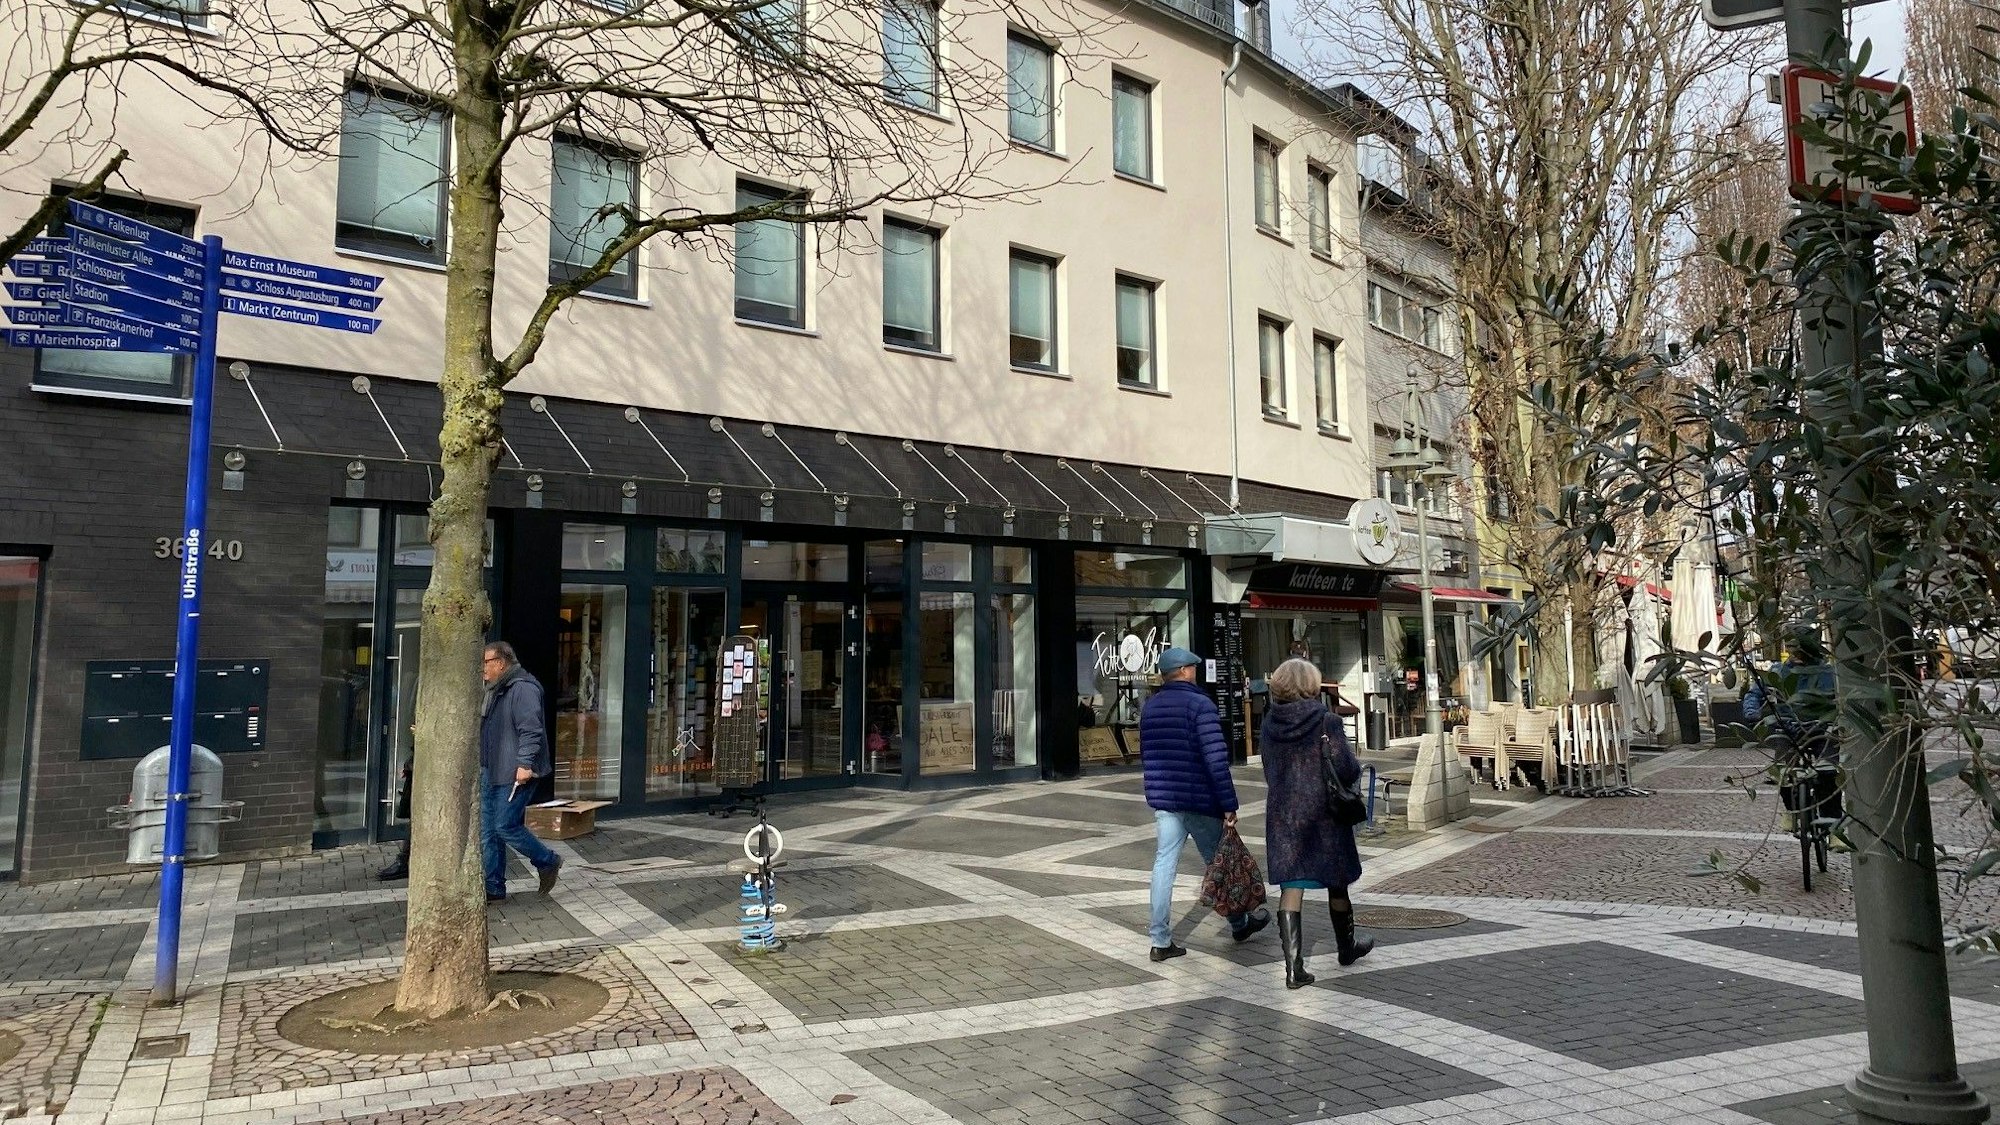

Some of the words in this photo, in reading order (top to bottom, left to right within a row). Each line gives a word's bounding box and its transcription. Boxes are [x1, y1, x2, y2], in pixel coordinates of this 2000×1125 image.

[108, 217, 150, 240] Falkenlust
[181, 243, 196, 255] 2300
[78, 233, 130, 259] Falkenluster
[132, 250, 154, 266] Allee
[183, 267, 195, 278] 300
[225, 253, 247, 267] Max
[250, 258, 274, 272] Ernst
[277, 262, 318, 279] Museum
[349, 277, 363, 287] 900
[364, 280, 371, 288] m
[37, 287, 70, 299] Giesle
[76, 258, 126, 282] Schlosspark
[181, 290, 193, 301] 300
[193, 295, 200, 303] m
[255, 280, 285, 295] Schloss
[286, 287, 340, 306] Augustusburg
[348, 298, 362, 307] 400
[17, 310, 61, 323] Brühler
[75, 283, 109, 302] Stadion
[181, 313, 192, 324] 100
[192, 318, 199, 326] m
[238, 301, 269, 315] Markt
[272, 306, 320, 324] (Zentrum)
[347, 319, 361, 329] 100
[362, 323, 370, 331] m
[34, 333, 121, 349] Marienhospital
[85, 312, 154, 338] Franziskanerhof
[179, 336, 190, 347] 100
[190, 341, 198, 349] m
[183, 528, 200, 599] Uhlstraße
[208, 539, 243, 560] 40
[690, 762, 713, 771] FUCH
